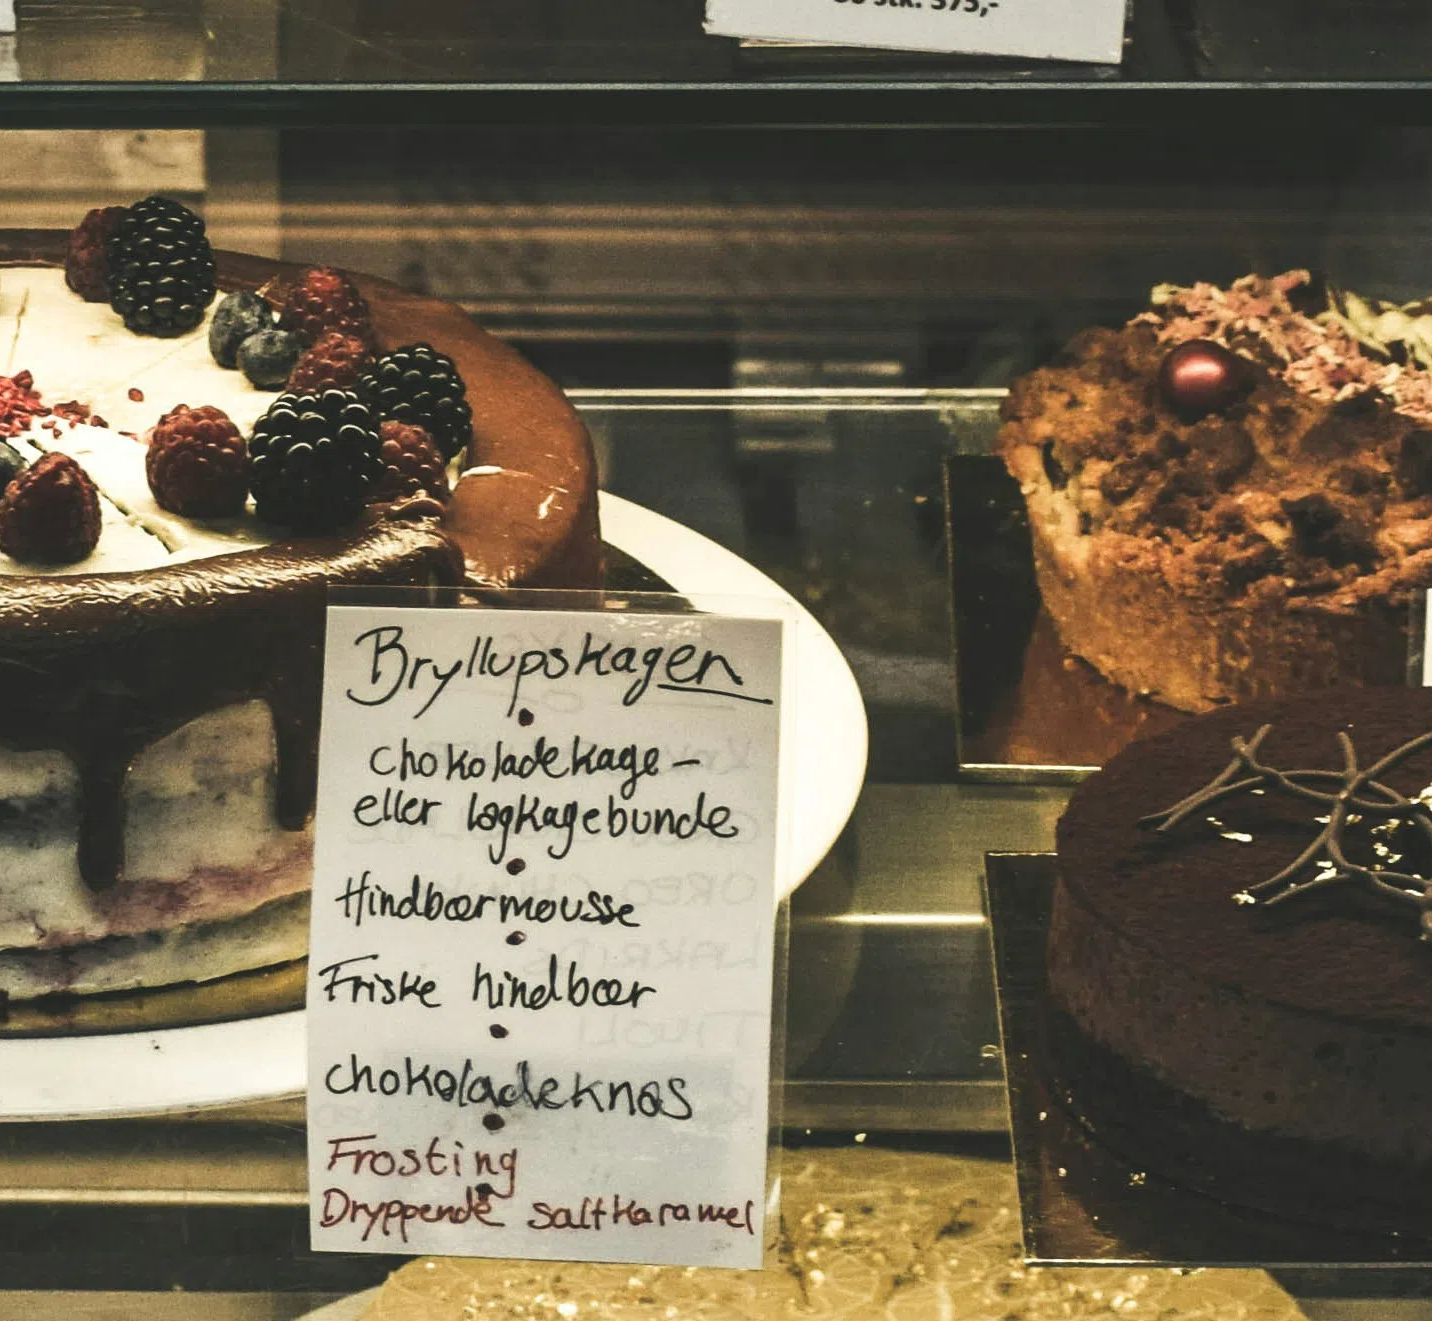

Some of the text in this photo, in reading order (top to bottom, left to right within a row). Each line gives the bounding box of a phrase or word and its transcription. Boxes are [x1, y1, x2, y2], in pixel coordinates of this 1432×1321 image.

[347, 626, 742, 717] Bryllupskagen
[354, 792, 442, 826] eller
[319, 954, 441, 1008] Friske
[328, 1135, 518, 1198] Frosting
[320, 1188, 505, 1243] Dryppende
